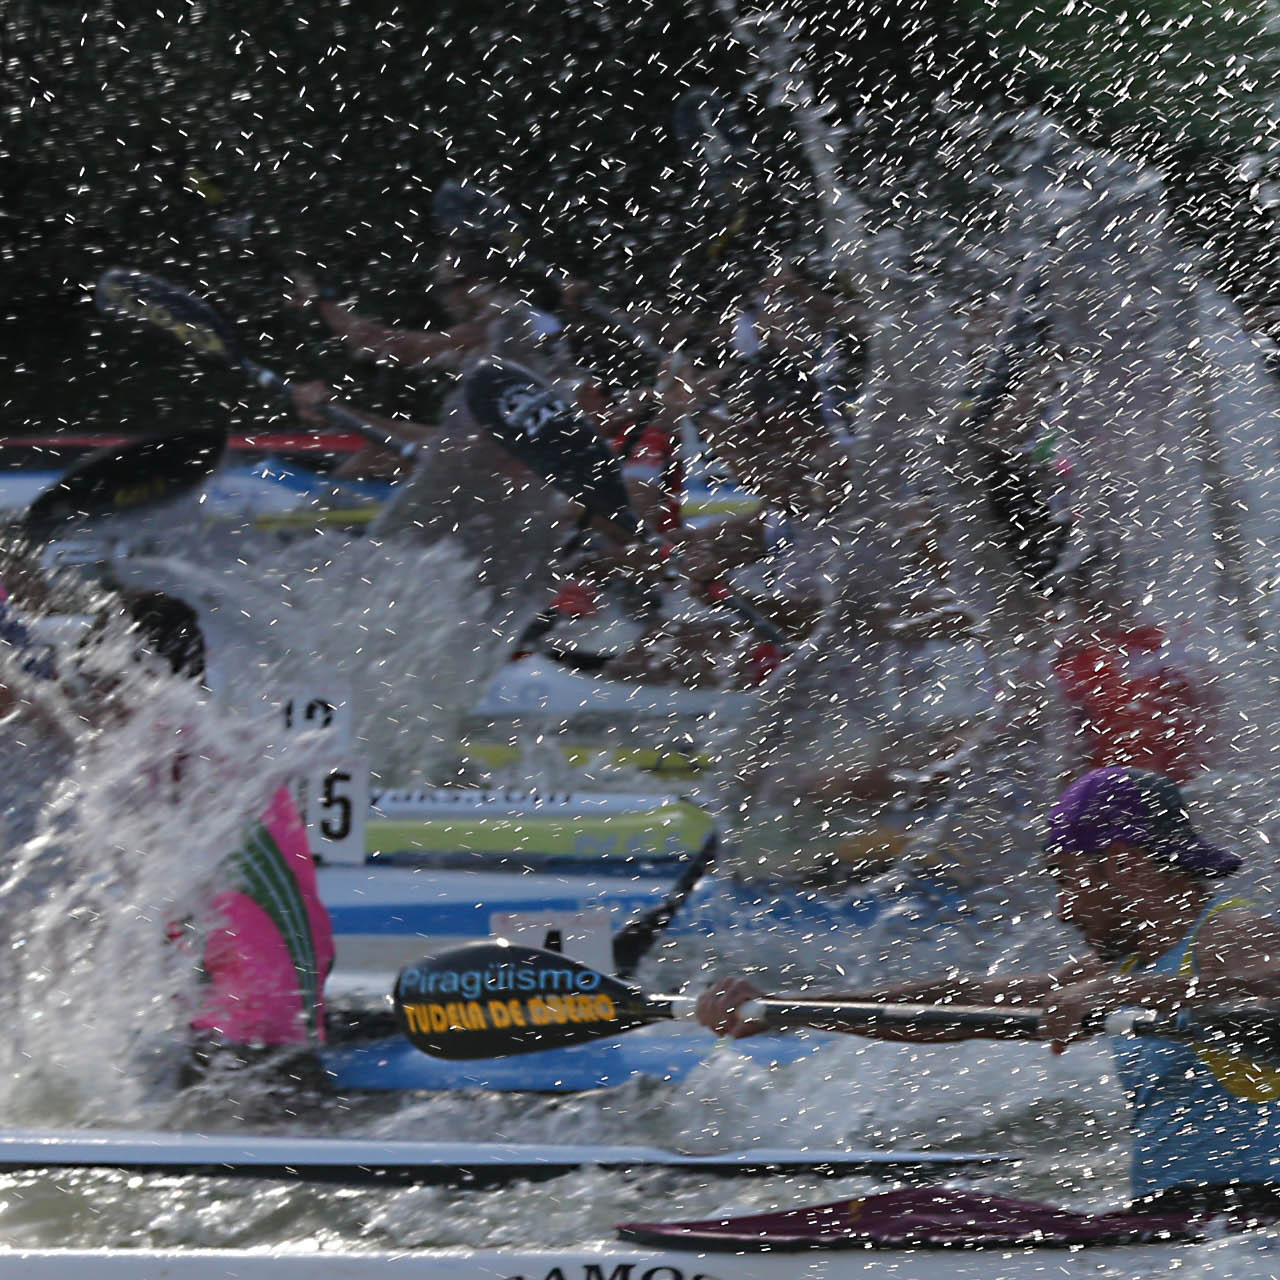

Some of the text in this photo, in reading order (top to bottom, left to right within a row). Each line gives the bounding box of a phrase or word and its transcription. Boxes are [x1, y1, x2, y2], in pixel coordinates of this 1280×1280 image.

[400, 963, 601, 998] Piragüismo
[403, 1002, 487, 1033] TUDELA
[488, 999, 526, 1028] DE
